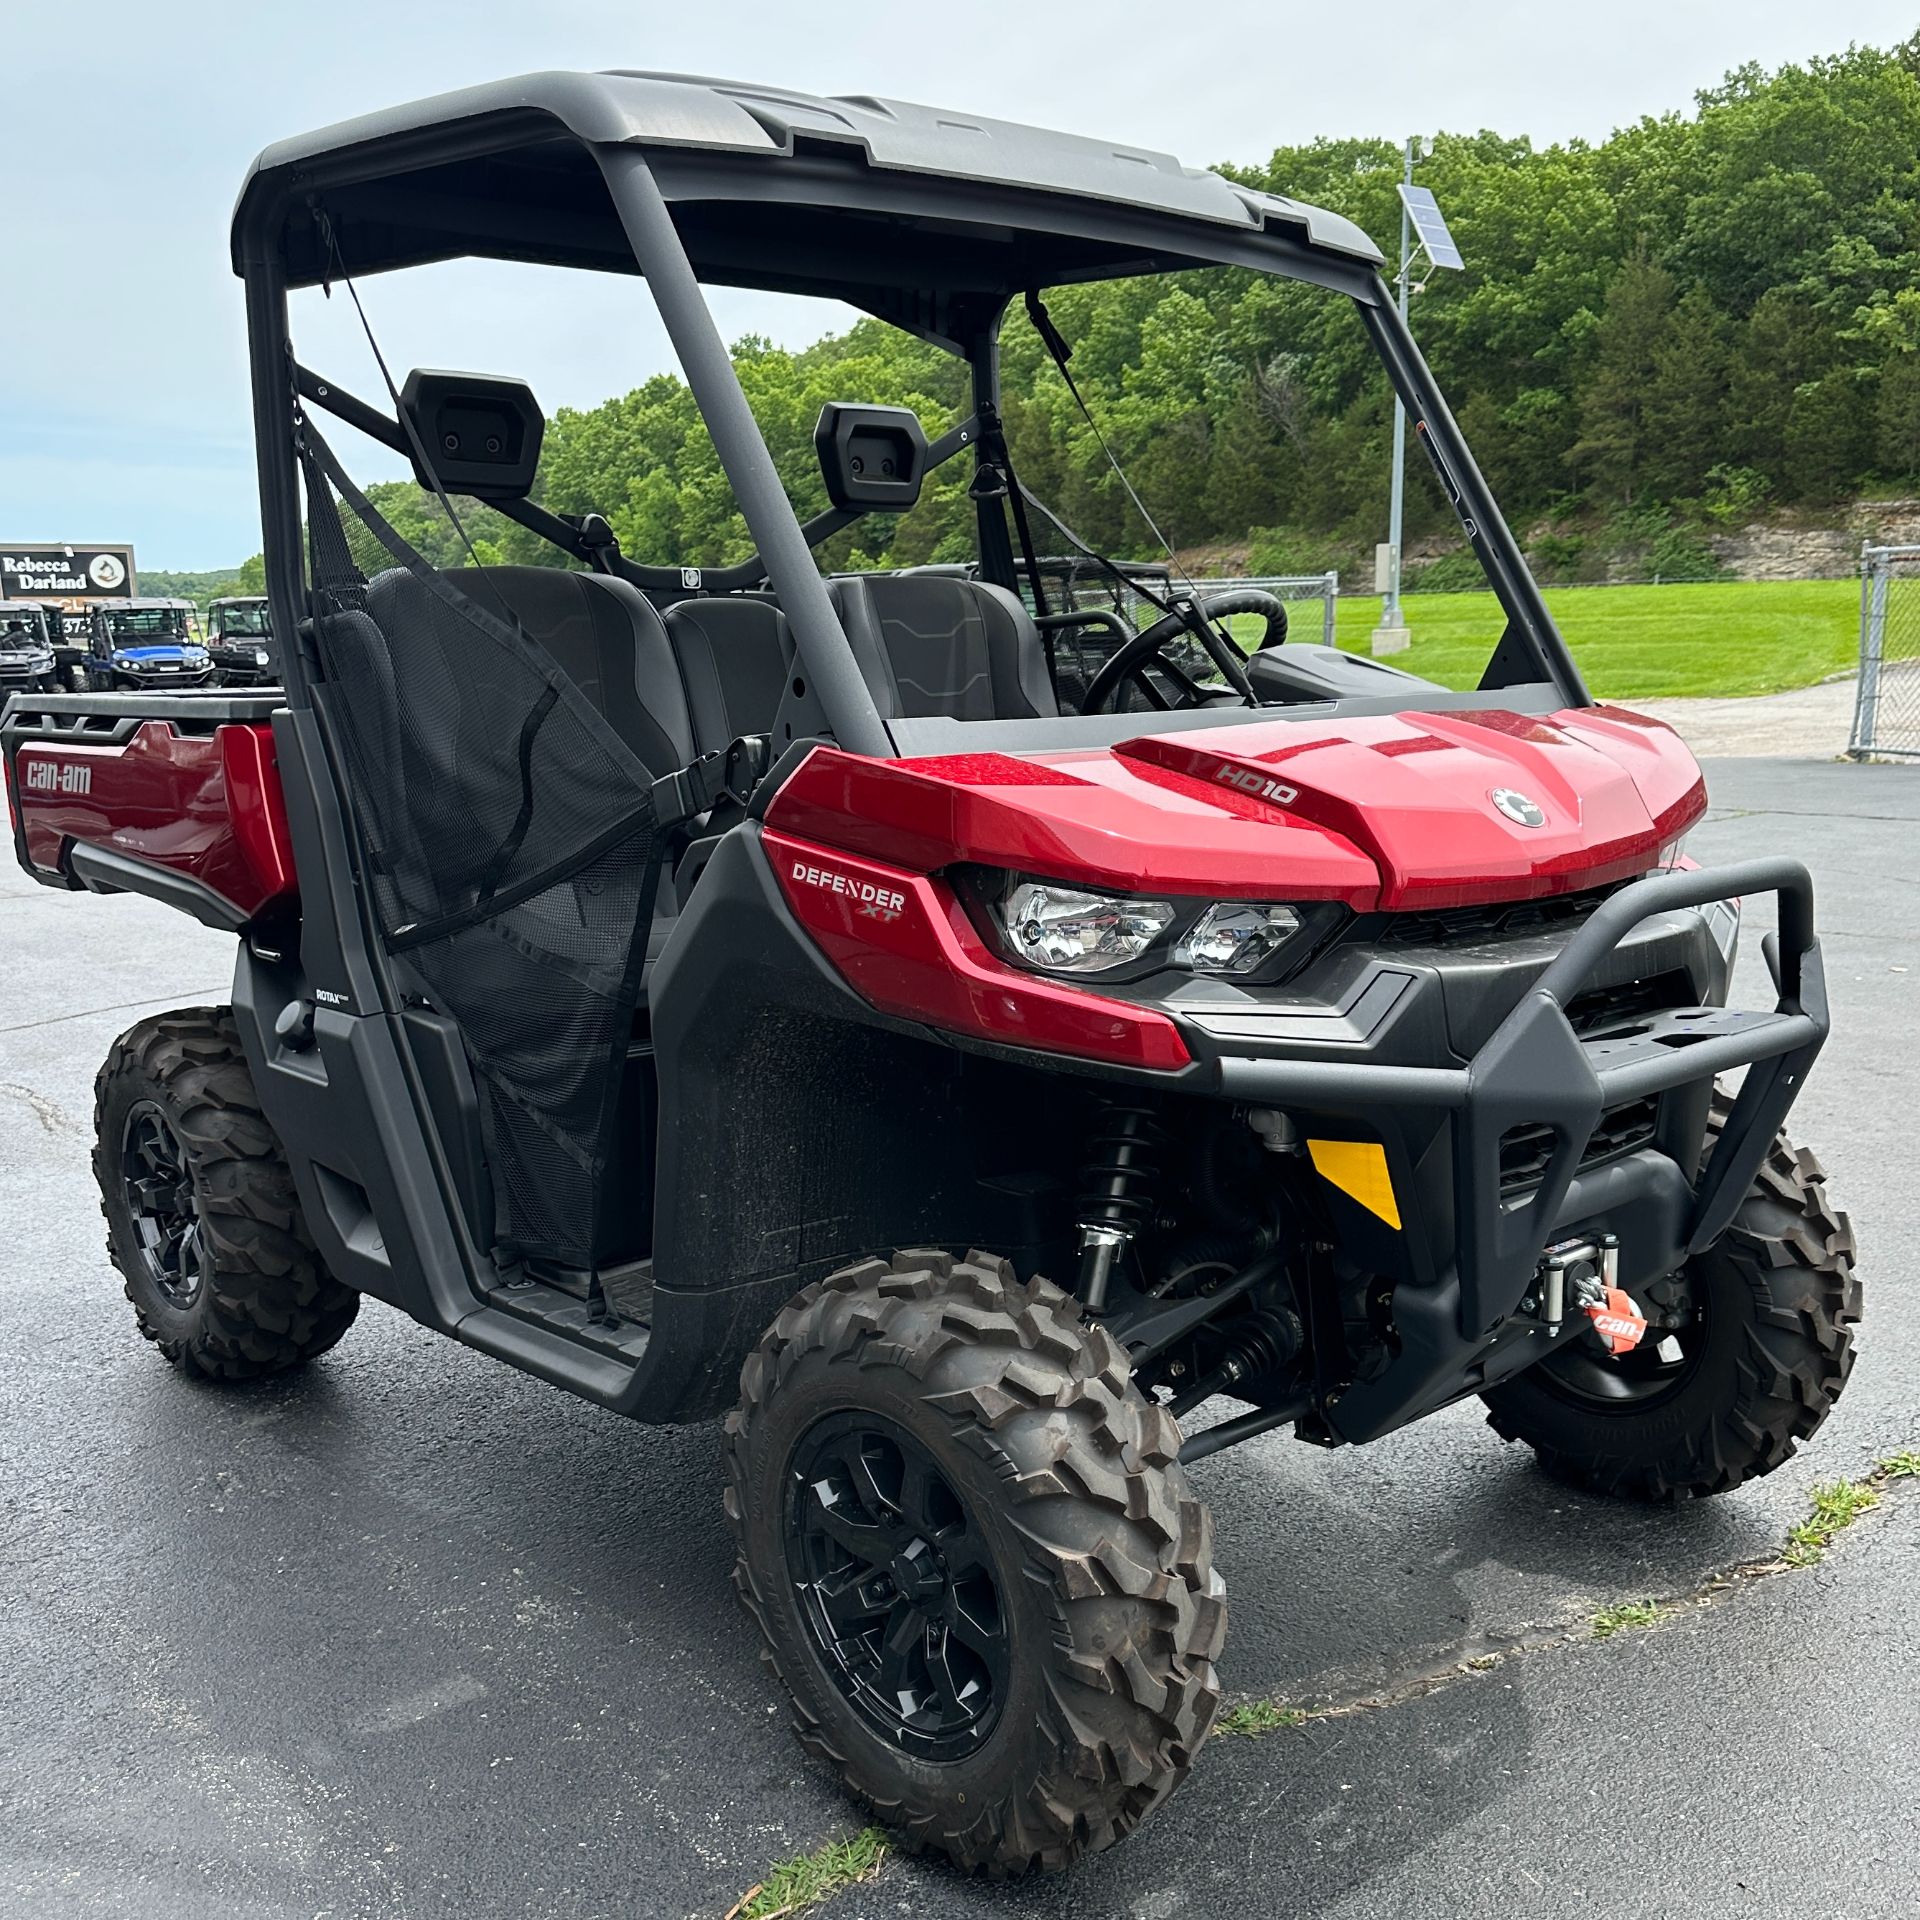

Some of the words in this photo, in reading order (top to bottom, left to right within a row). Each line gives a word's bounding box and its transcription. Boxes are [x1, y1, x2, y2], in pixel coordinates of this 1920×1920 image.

[2, 556, 71, 573] Rebecca
[18, 573, 88, 590] Darland
[27, 761, 92, 794] can-am
[1216, 765, 1299, 804] HD10
[792, 862, 905, 912] DEFENDER
[861, 902, 902, 922] XT
[316, 989, 341, 1005] ROTAX
